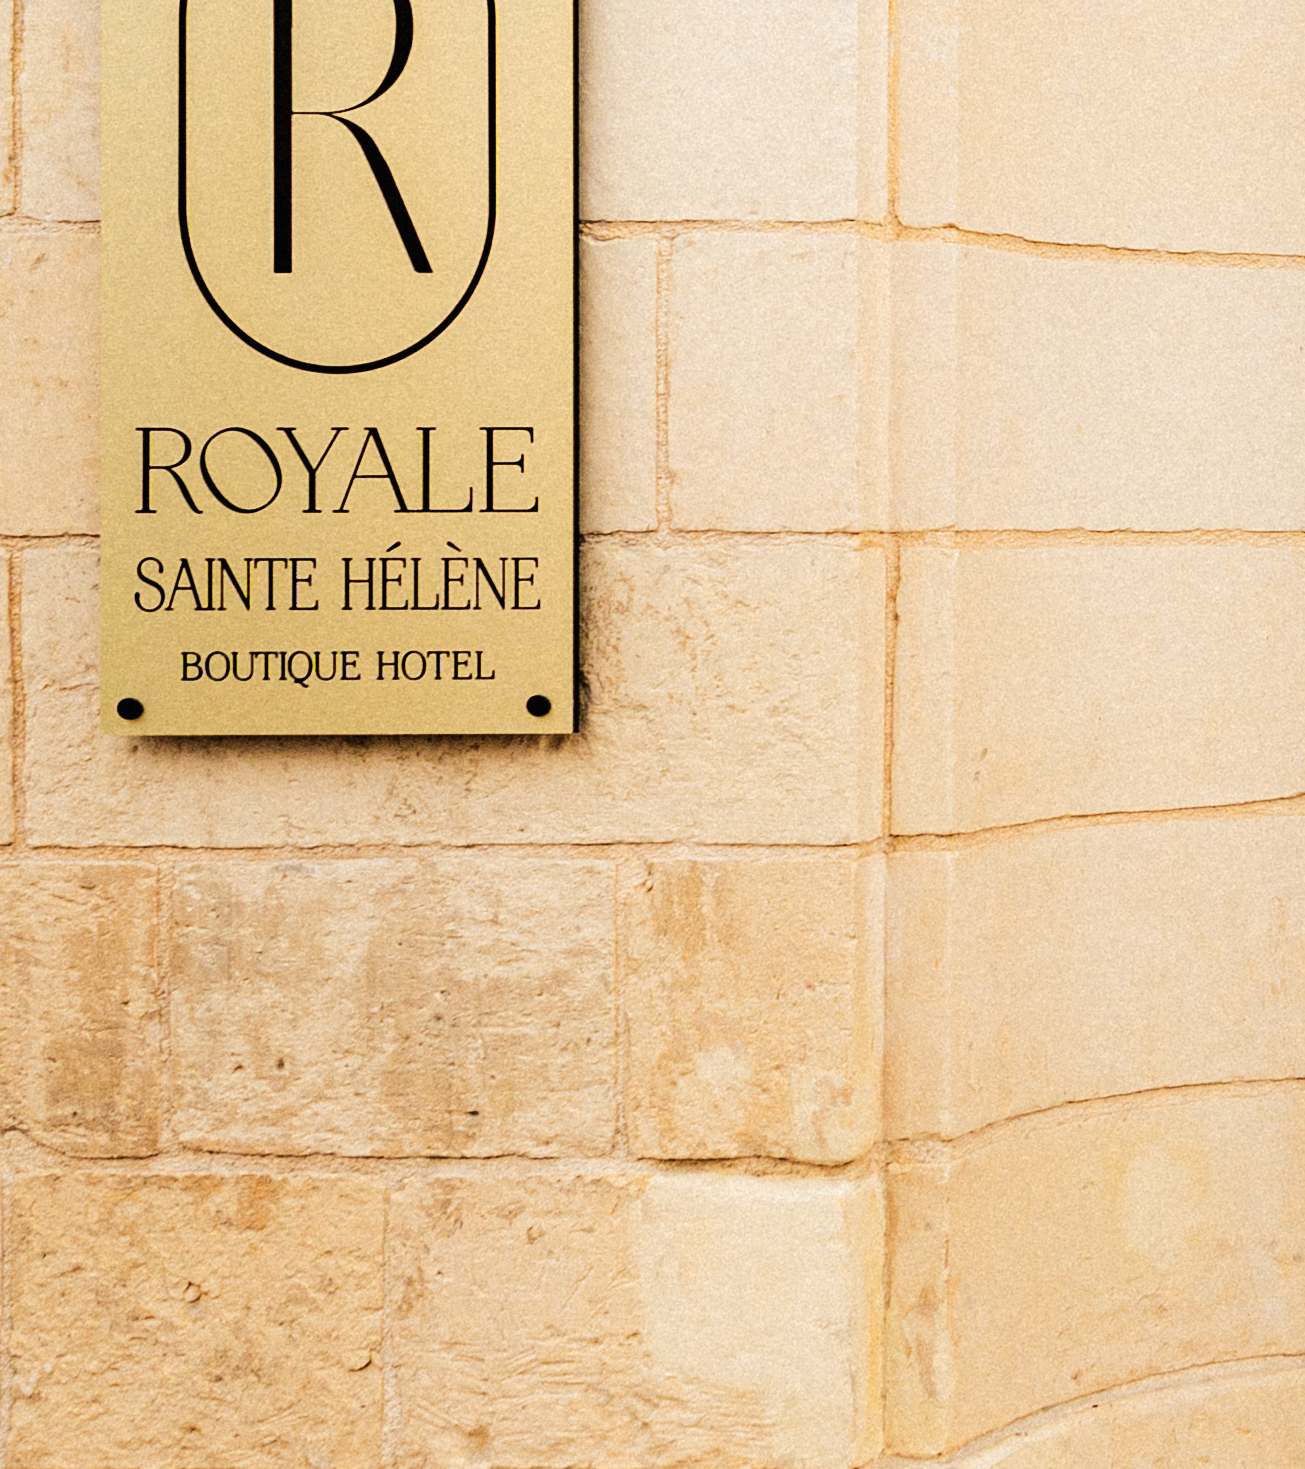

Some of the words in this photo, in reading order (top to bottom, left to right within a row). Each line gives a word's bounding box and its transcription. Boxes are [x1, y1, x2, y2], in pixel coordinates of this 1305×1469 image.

[134, 426, 539, 515] ROYALE
[134, 556, 319, 613] SAINTE
[341, 541, 541, 613] HÉLÈNE
[180, 650, 361, 689] BOUTIQUE
[376, 650, 496, 682] HOTEL
